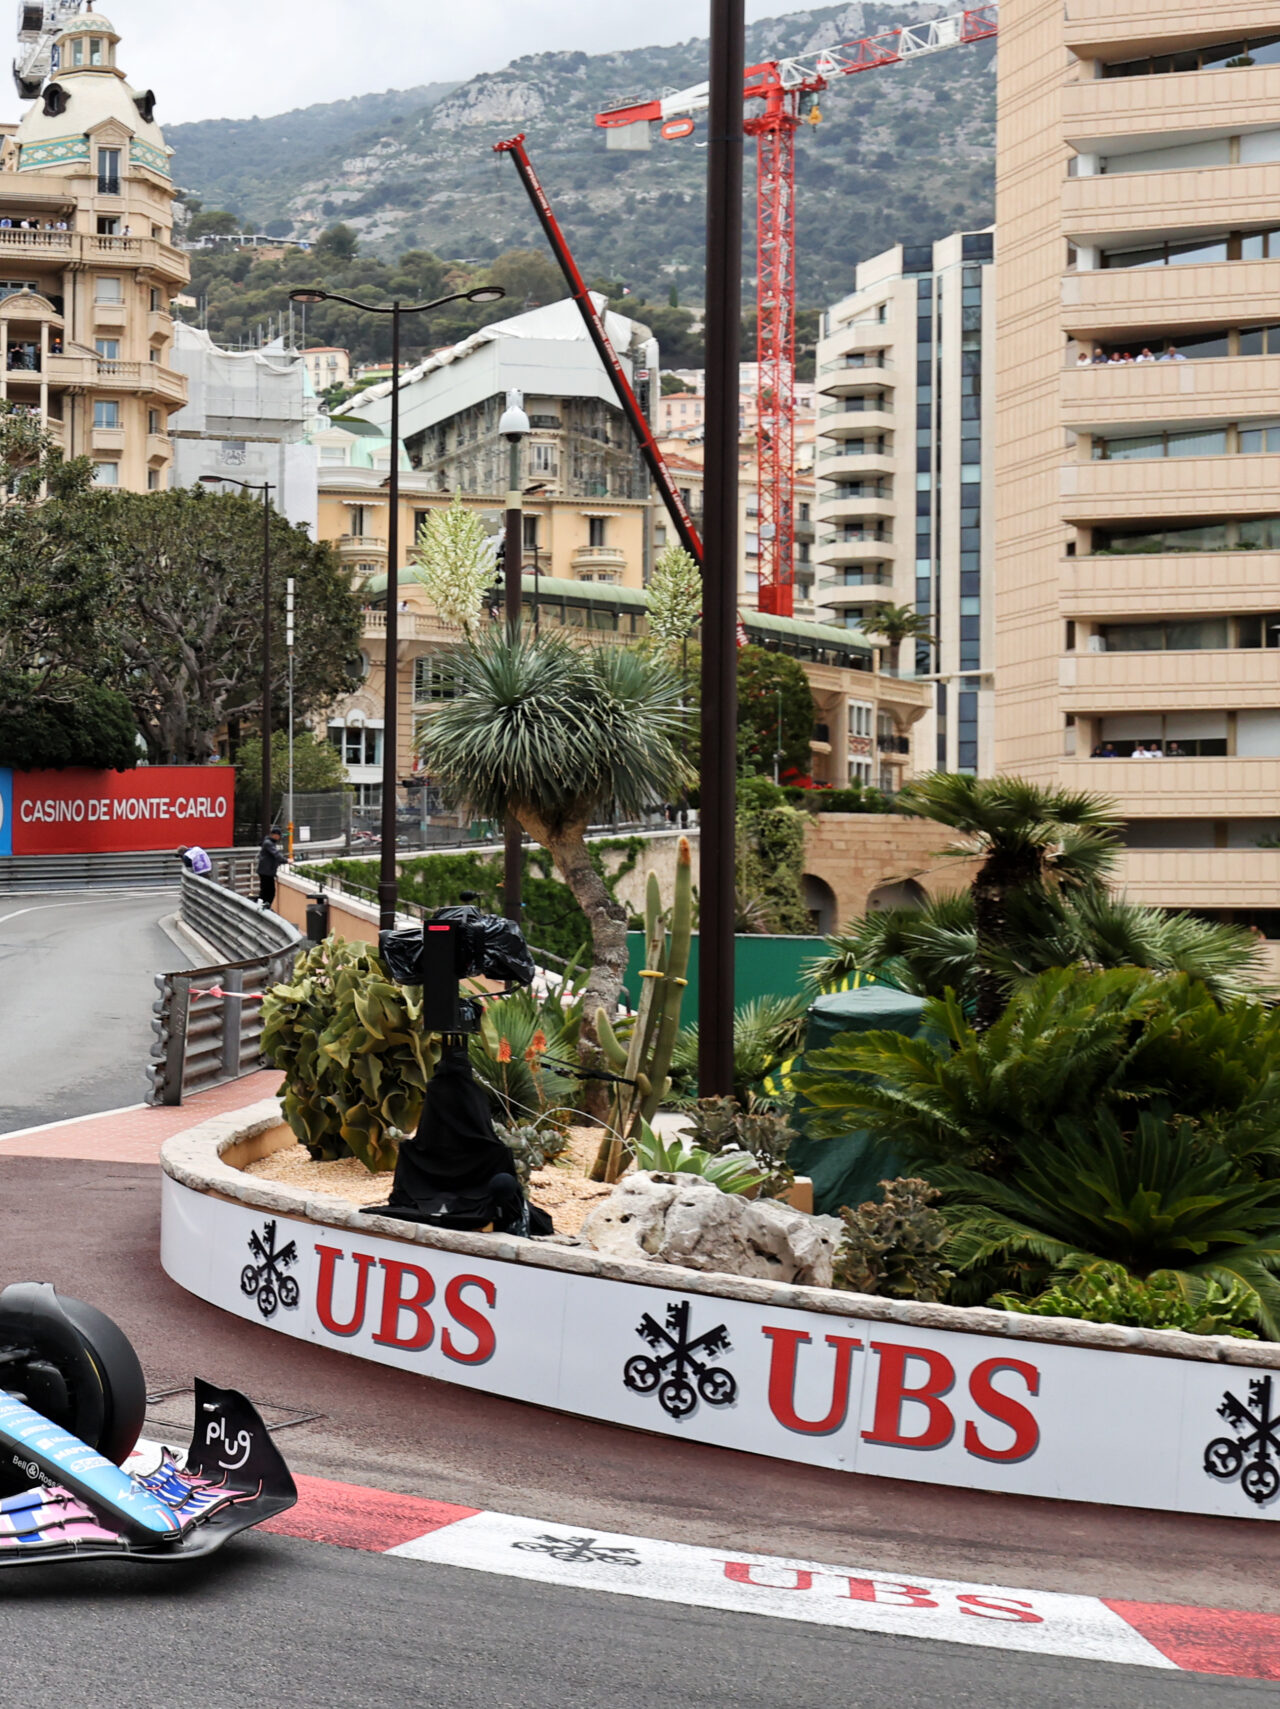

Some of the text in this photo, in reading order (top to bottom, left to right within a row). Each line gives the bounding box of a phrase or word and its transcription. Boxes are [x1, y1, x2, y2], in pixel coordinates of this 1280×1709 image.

[20, 796, 228, 823] CASINO DE MONTE-CARLO
[314, 1243, 498, 1367] UBS
[762, 1325, 1041, 1464] UBS
[12, 1455, 27, 1471] Bell
[38, 1471, 56, 1488] Ross
[206, 1417, 251, 1470] plug
[712, 1557, 1045, 1625] UBS
